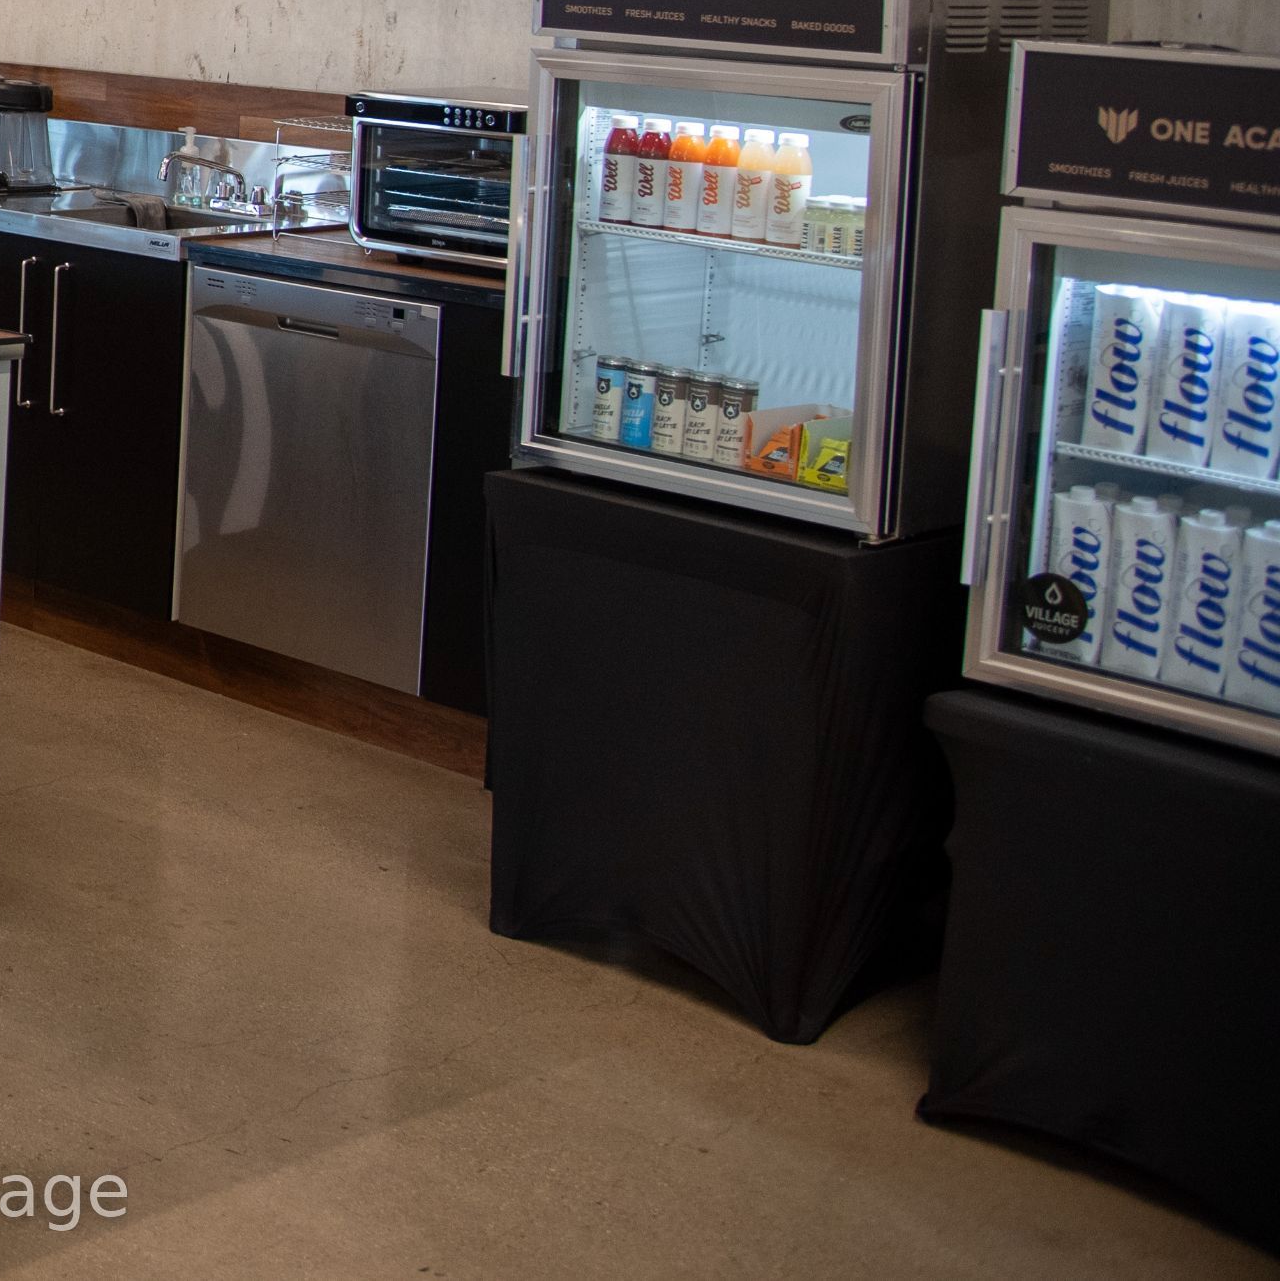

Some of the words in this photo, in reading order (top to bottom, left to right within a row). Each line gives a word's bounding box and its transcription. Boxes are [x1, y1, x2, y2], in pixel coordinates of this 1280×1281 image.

[565, 4, 613, 17] SMOOTHIES
[625, 8, 652, 19] FRESH
[654, 11, 686, 22] JUICES
[700, 13, 739, 25] HEALTHY
[741, 16, 777, 28] SNACKS
[791, 20, 822, 32] BAKED
[823, 22, 856, 35] GOODS
[1150, 118, 1210, 146] ONE
[604, 158, 618, 193] Well
[638, 162, 654, 198] Well
[668, 165, 682, 201] Well
[703, 170, 718, 206] Well
[736, 173, 751, 209] Well
[1048, 162, 1112, 179] SMOOTHIES
[1128, 170, 1165, 184] FRESH
[1166, 175, 1210, 190] JUICES
[773, 177, 791, 215] Well
[832, 226, 843, 254] ELIXIR
[1092, 318, 1143, 436] flow
[1159, 327, 1214, 448] flow
[1222, 336, 1280, 459] flow
[1112, 538, 1165, 659] flow
[1174, 552, 1231, 674] flow
[1025, 605, 1079, 629] VILLAGE
